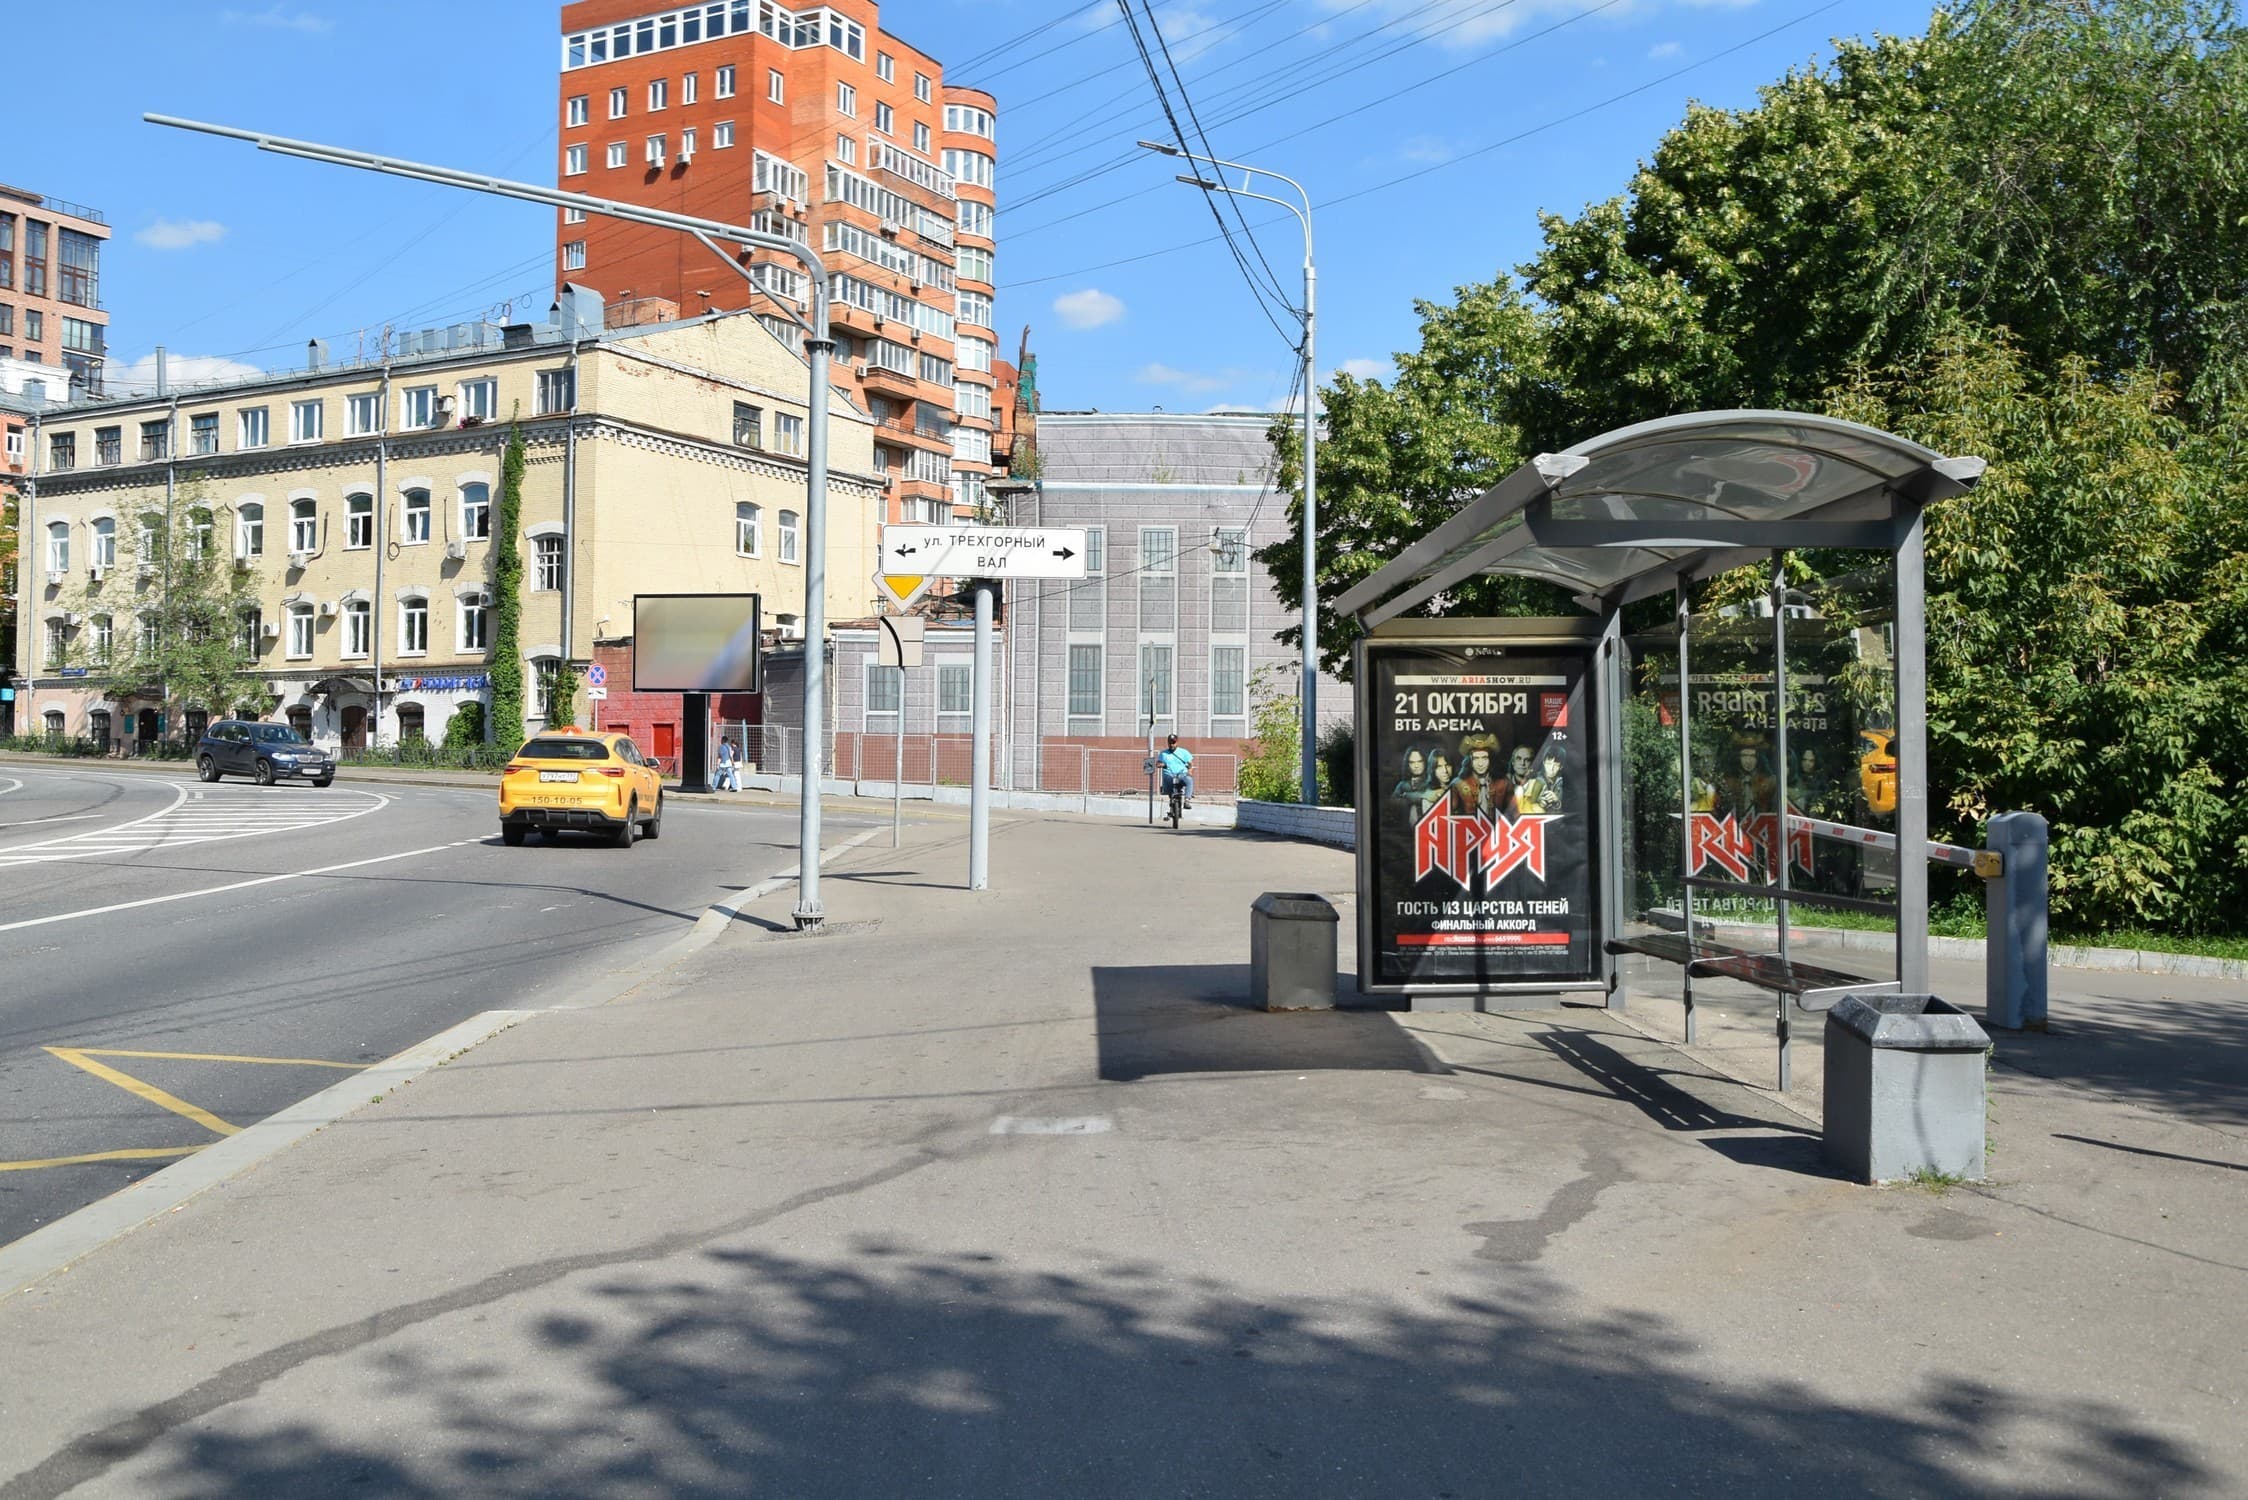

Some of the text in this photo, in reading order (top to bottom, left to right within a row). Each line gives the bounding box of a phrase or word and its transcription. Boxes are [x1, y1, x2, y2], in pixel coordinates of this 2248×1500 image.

[924, 534, 1045, 549] ул. ТРЕХГОРНЫЙ
[977, 556, 1007, 568] ВАЛ
[1395, 693, 1418, 714] 21
[1427, 692, 1527, 715] ОКТЯБРЯ
[1395, 719, 1484, 731] ВТБ АРЕНА
[1552, 731, 1567, 740] 12+
[532, 796, 582, 805] 150-10-05
[1415, 789, 1565, 892] АРИЯ
[1397, 898, 1568, 917] ГОСТЬ ИЗ ЦАРСТВА ТЕНЕЙ
[1432, 917, 1536, 931] ФИНАЛЬНЫЙ АККОРД
